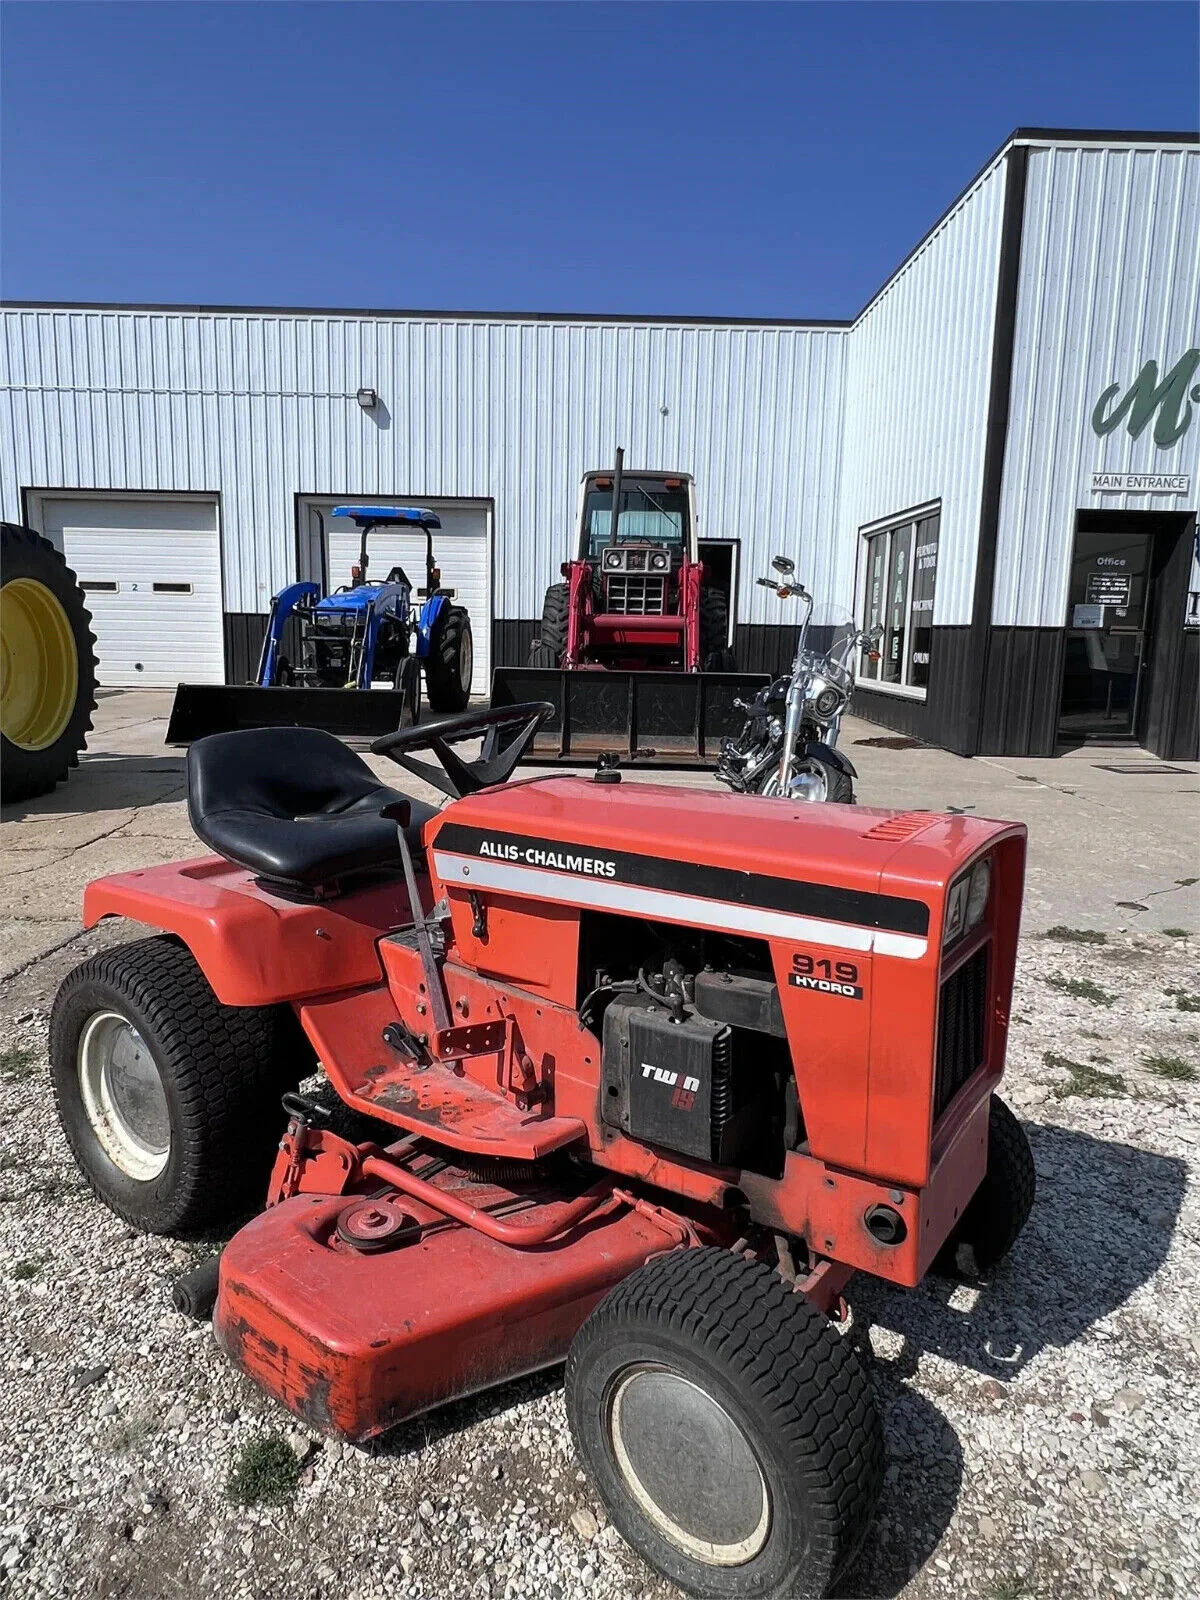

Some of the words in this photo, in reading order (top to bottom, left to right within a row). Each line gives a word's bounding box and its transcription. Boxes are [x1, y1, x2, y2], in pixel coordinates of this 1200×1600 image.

[1092, 348, 1200, 450] M
[1092, 475, 1122, 488] MAIN
[1126, 476, 1185, 489] ENTRANCE
[1096, 557, 1126, 566] Office
[132, 583, 138, 592] 2
[891, 550, 905, 660] SALE
[479, 841, 617, 877] ALLIS-CHALMERS
[792, 953, 858, 983] 919
[795, 975, 855, 996] HYDRO
